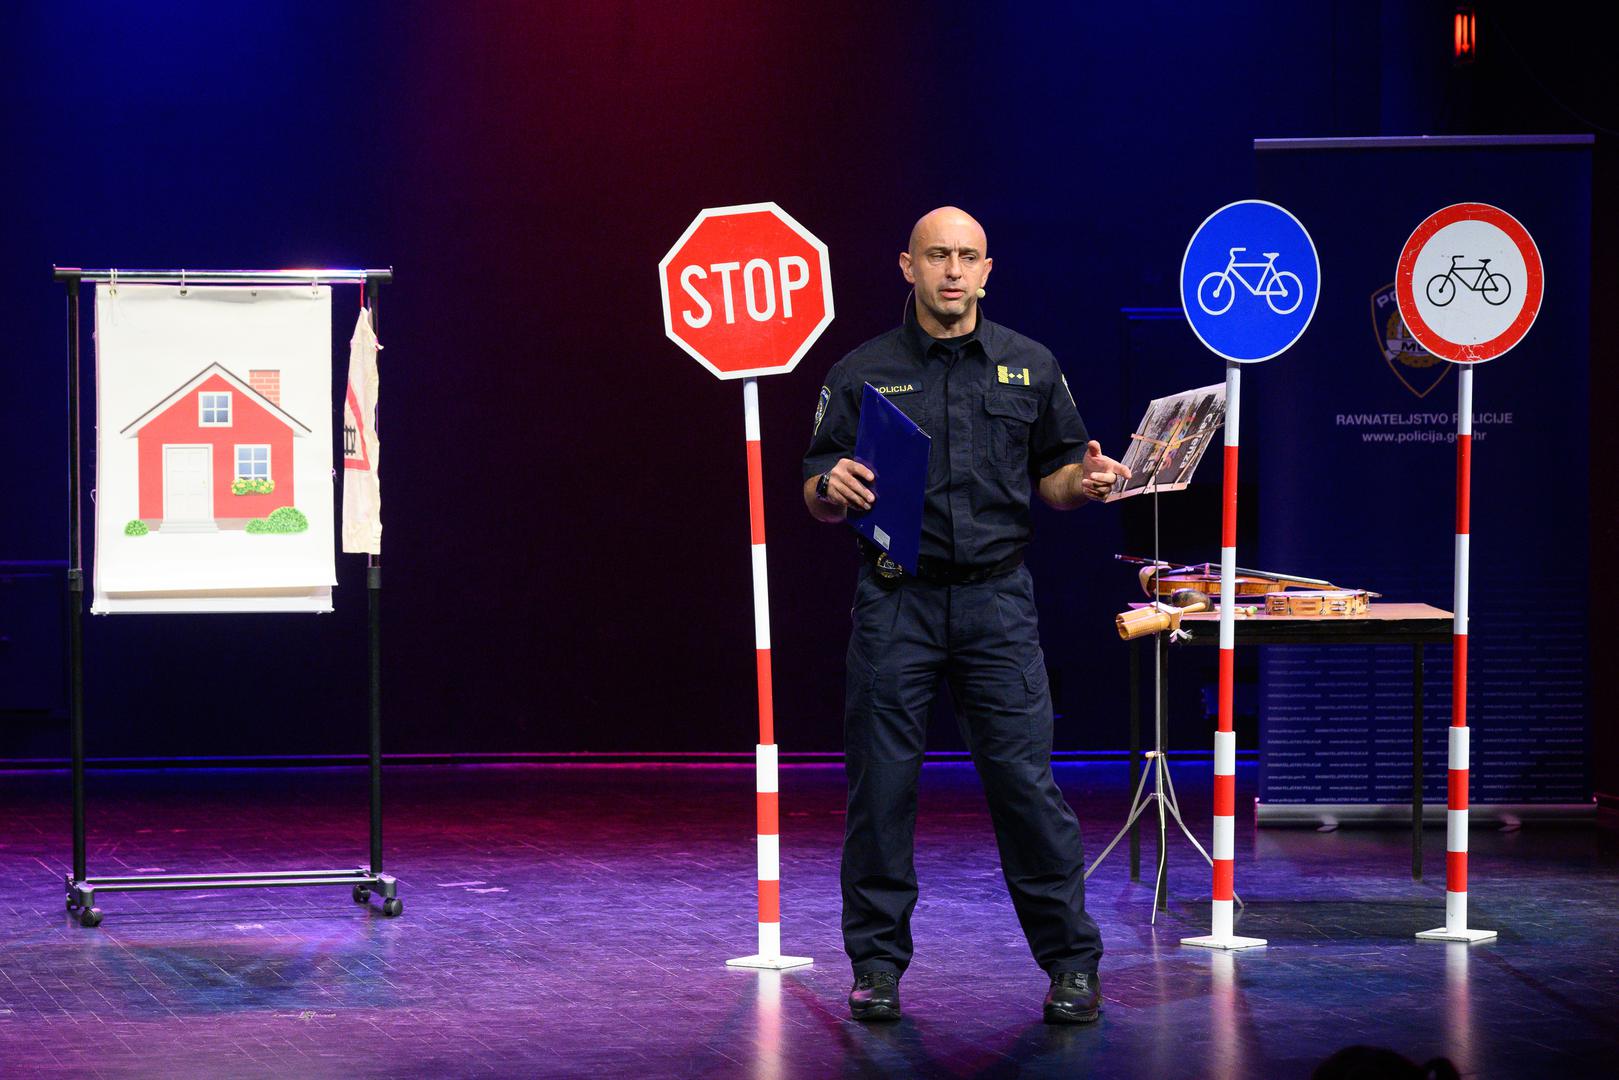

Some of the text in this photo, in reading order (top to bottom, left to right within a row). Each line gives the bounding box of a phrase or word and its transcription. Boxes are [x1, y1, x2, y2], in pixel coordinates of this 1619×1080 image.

[680, 255, 810, 329] STOP
[1336, 412, 1513, 425] RAVNATELJSTVO PLICIJE
[1362, 430, 1488, 444] www.policija.g.hr
